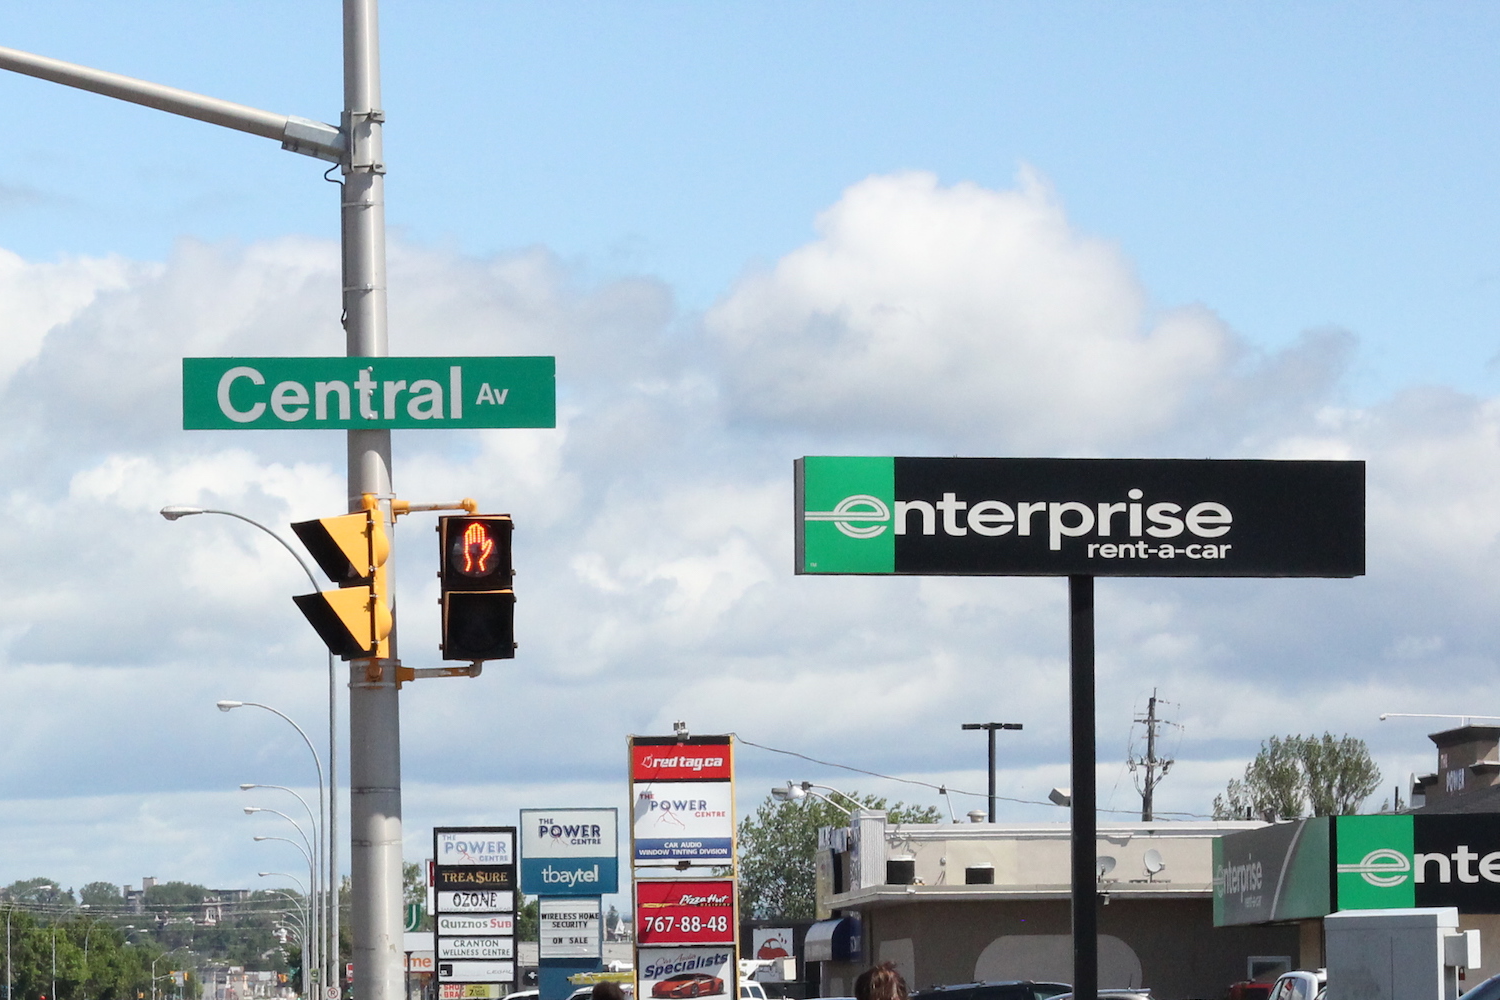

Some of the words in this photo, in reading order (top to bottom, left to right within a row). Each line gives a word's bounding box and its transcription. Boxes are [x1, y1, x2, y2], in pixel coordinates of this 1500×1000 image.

[217, 366, 462, 423] Central
[475, 383, 508, 405] Av
[806, 488, 1233, 551] enterprise
[1087, 540, 1231, 559] rent-a-car
[650, 800, 707, 811] POWER
[538, 824, 601, 839] POWER
[445, 841, 507, 854] POWER
[479, 854, 509, 862] CENTRE
[541, 864, 599, 887] tbaytel
[453, 892, 498, 908] OZONE
[644, 915, 728, 933] 767-88-48
[442, 948, 480, 956] WELLNESS
[482, 948, 510, 956] CENTRE
[454, 940, 499, 948] CRANTON
[644, 953, 729, 980] Specialists
